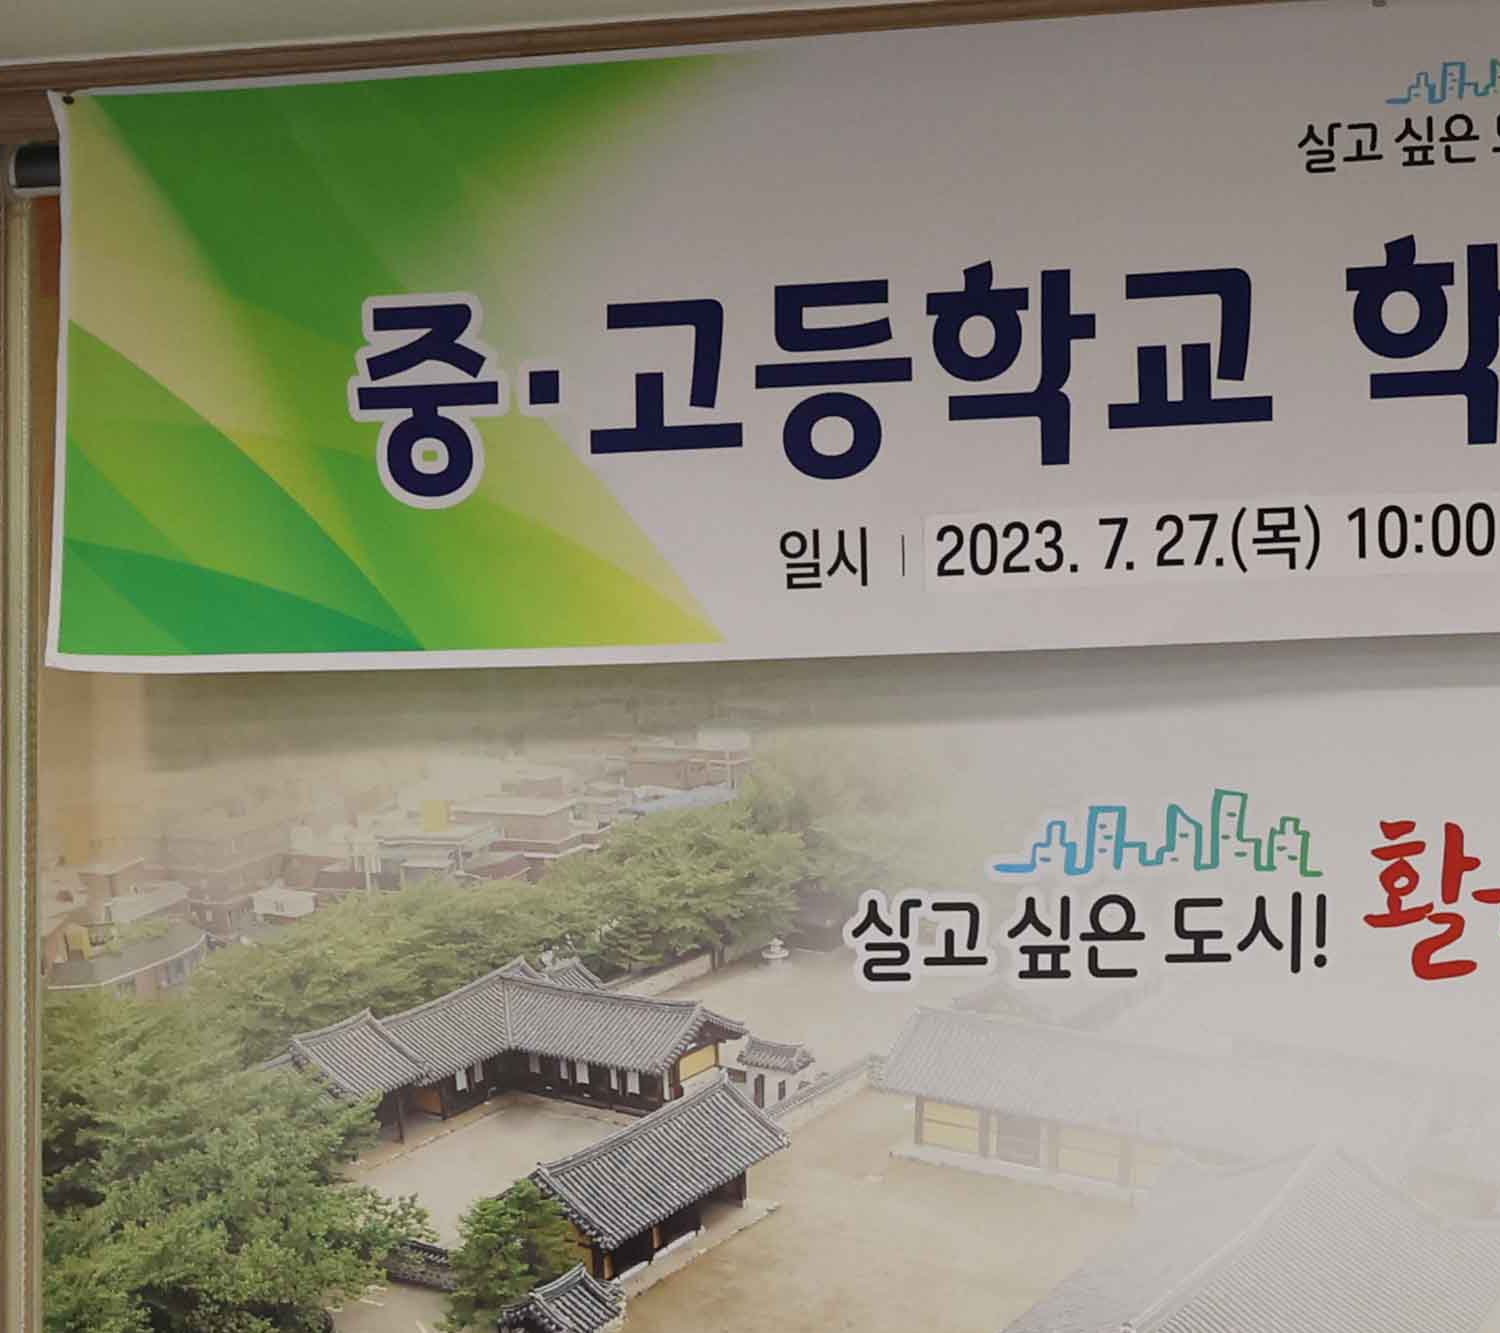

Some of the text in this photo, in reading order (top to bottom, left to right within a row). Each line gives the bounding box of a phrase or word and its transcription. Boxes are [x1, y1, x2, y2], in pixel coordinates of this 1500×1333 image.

[1297, 122, 1384, 174] 살고
[1394, 112, 1480, 167] 싶은
[779, 526, 868, 590] 일시
[936, 522, 1080, 577] 2023.
[1098, 517, 1136, 571] 7.
[1347, 502, 1496, 559] 10:00
[851, 898, 988, 982] 살고
[1007, 894, 1146, 980] 싶은
[1164, 891, 1327, 974] 도시!
